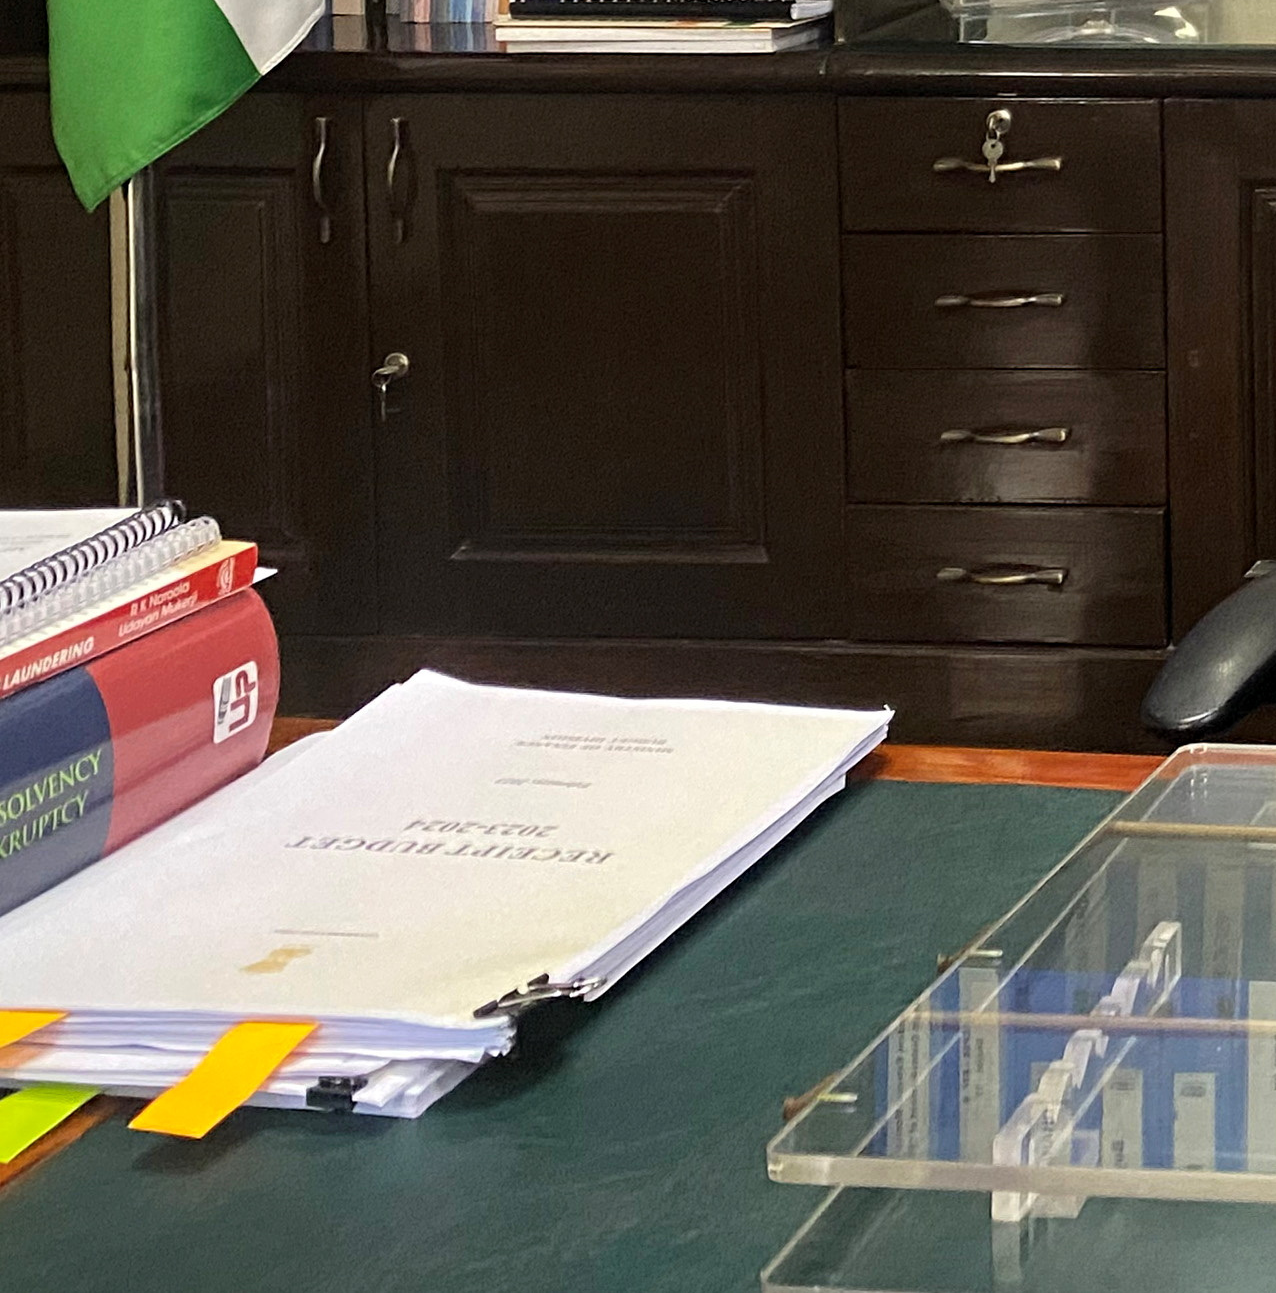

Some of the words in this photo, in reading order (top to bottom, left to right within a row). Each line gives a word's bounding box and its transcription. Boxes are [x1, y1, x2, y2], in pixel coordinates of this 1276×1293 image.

[118, 608, 160, 637] Udayan
[161, 590, 199, 617] Mukerji
[140, 600, 148, 613] K
[2, 636, 95, 691] LAUNDERING
[0, 748, 102, 825] SOLVENCY
[403, 819, 559, 840] 2023-2024
[282, 835, 447, 857] BUDGET
[442, 842, 615, 865] RECEIPT
